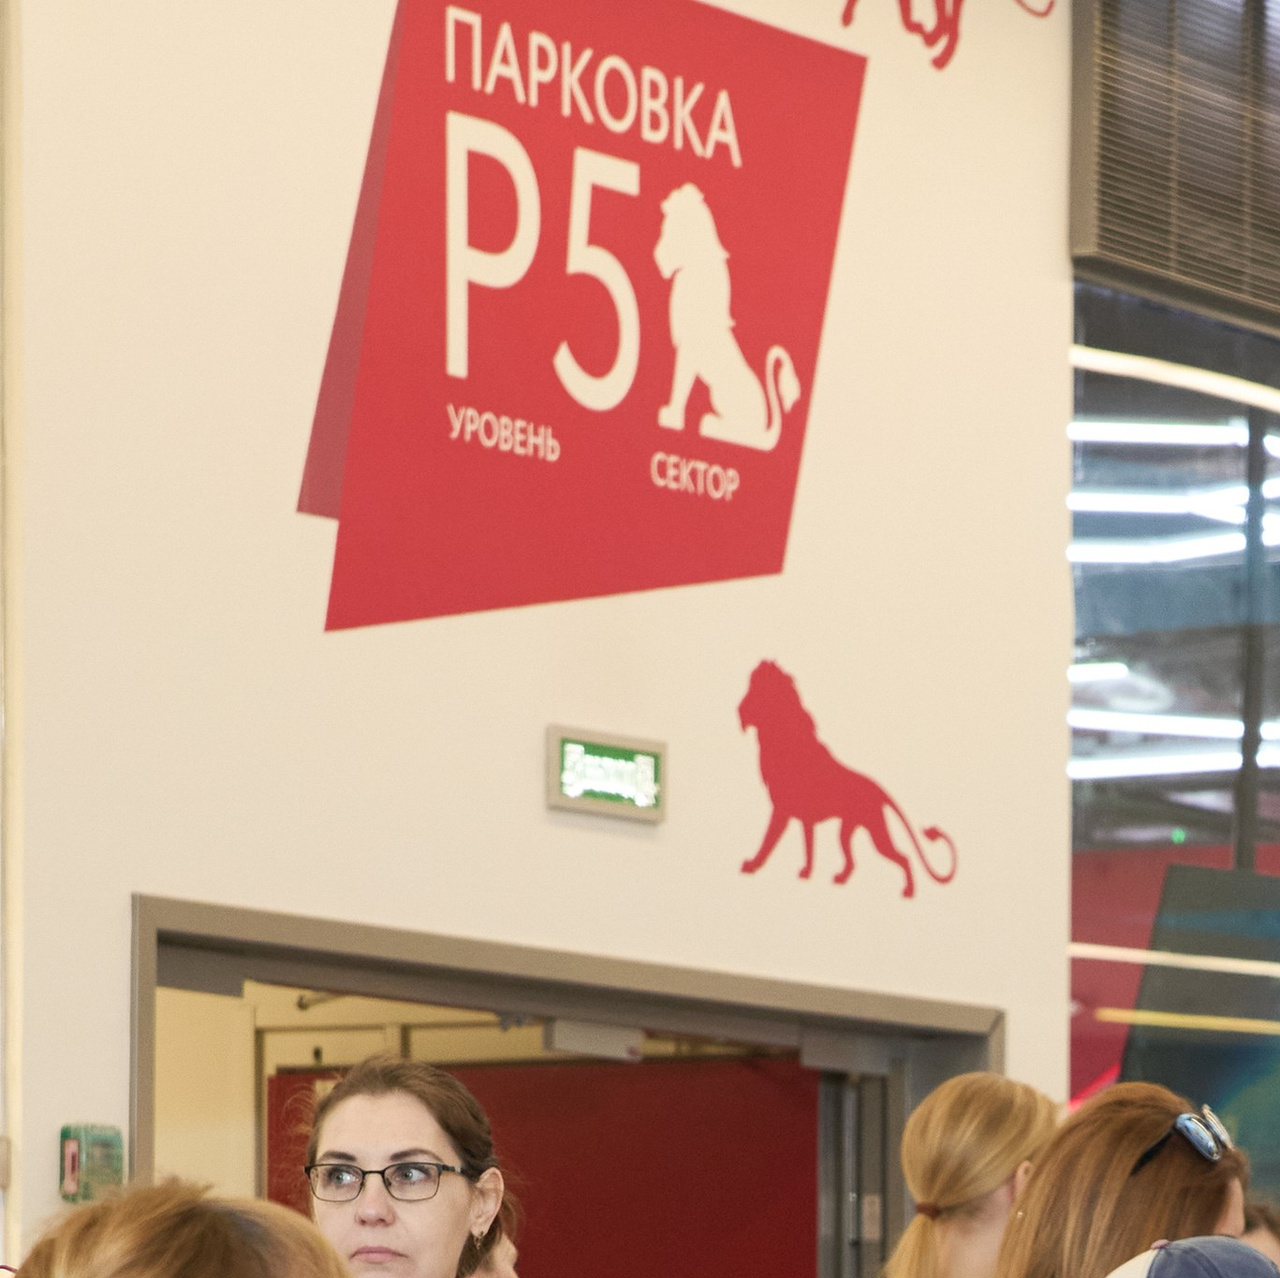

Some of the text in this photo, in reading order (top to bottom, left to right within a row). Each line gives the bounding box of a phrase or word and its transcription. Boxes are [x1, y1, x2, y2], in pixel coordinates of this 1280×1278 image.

[446, 5, 742, 169] ПАРКОВКА
[446, 402, 561, 463] УРОВЕНЬ
[650, 451, 740, 501] СЕКТОР
